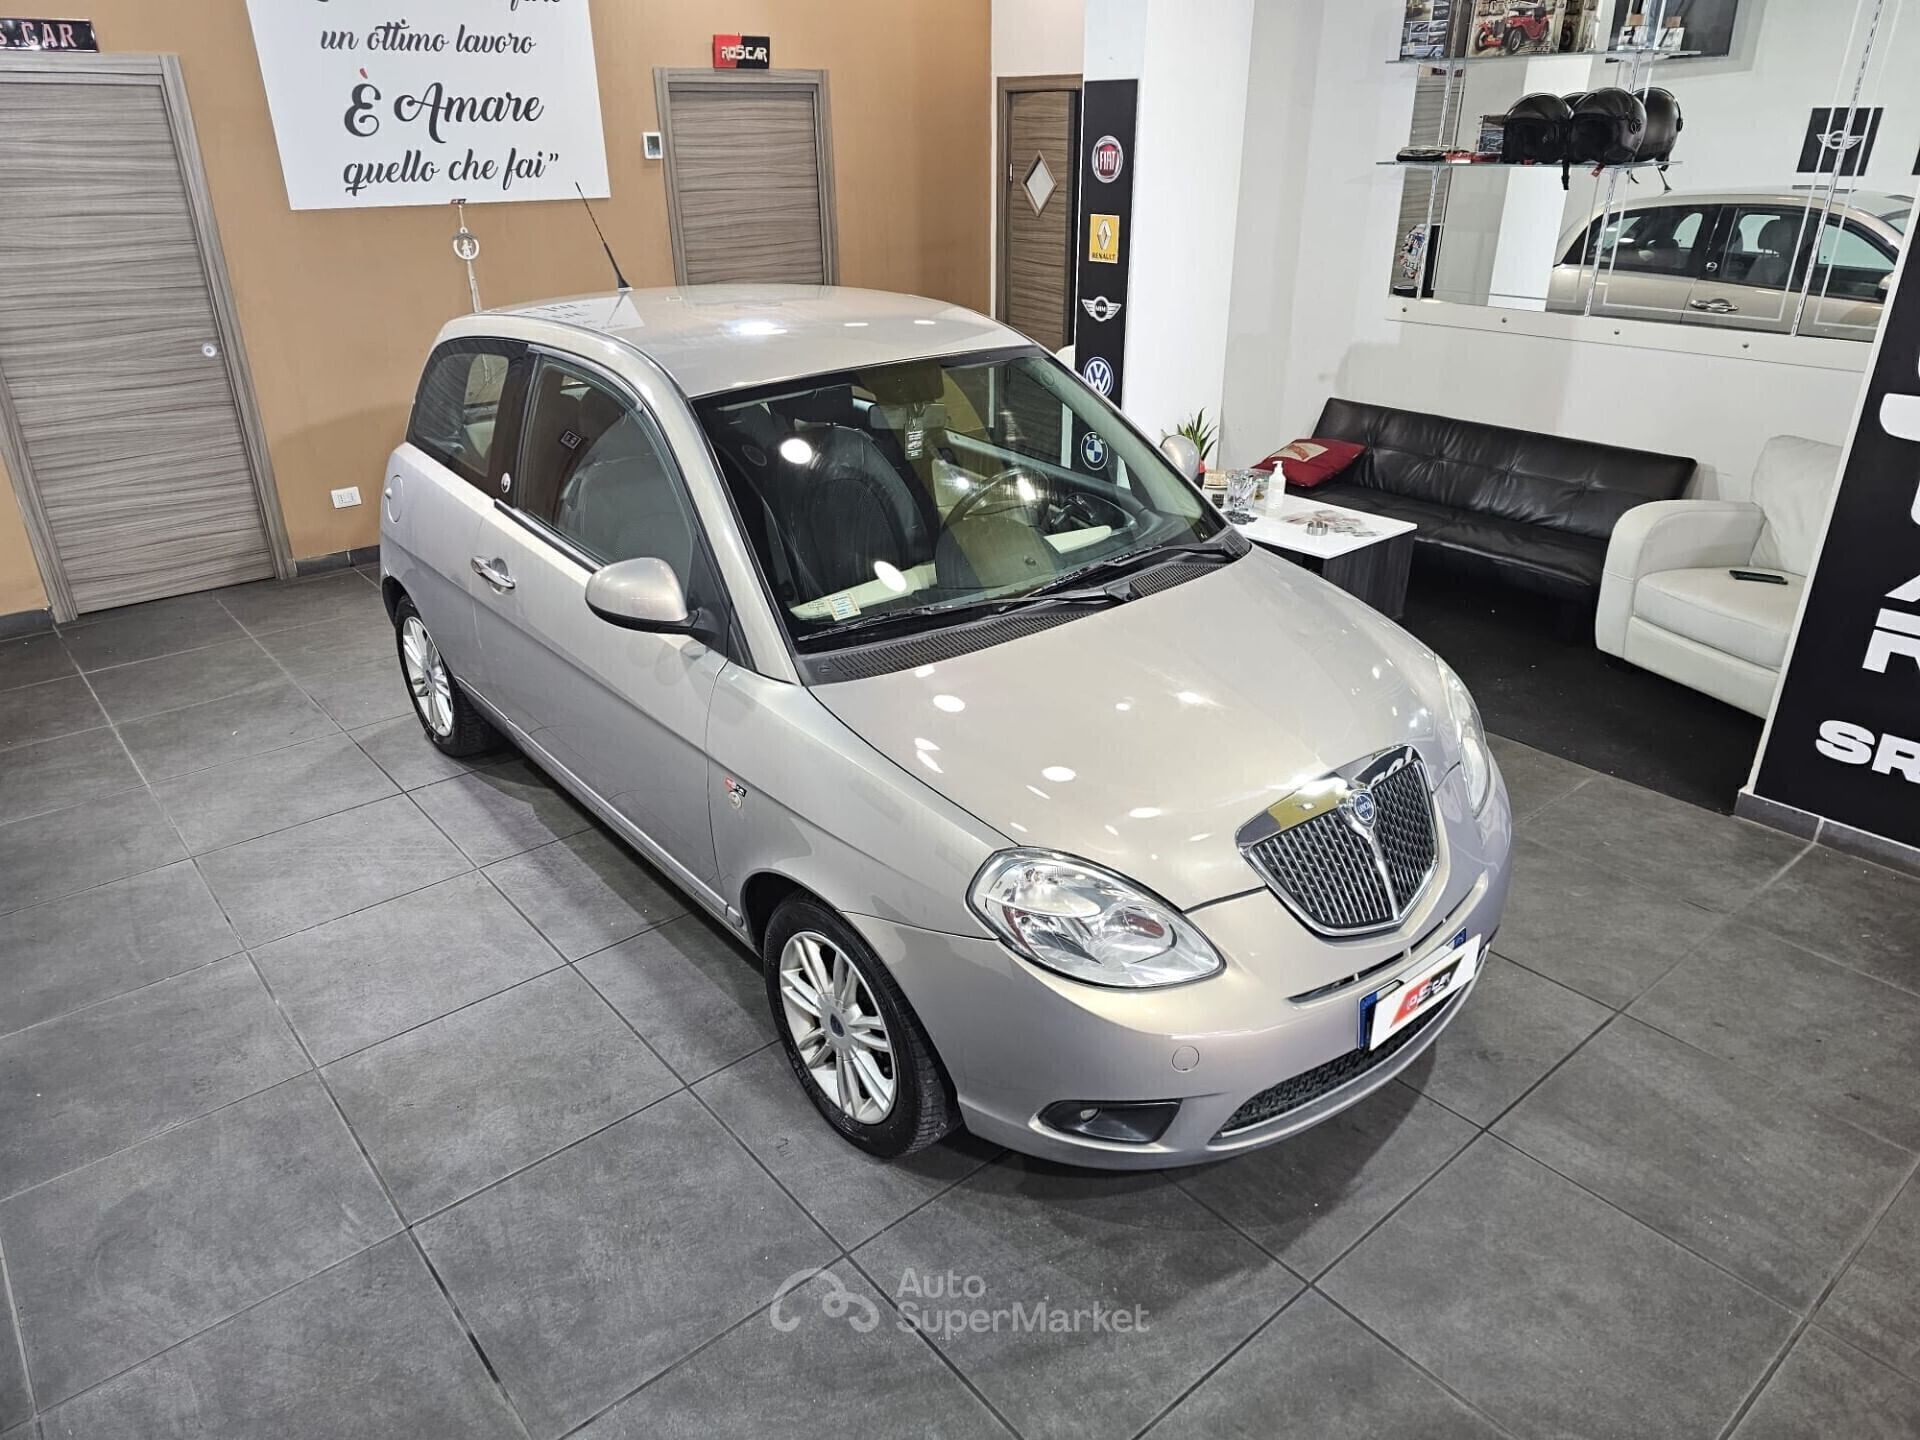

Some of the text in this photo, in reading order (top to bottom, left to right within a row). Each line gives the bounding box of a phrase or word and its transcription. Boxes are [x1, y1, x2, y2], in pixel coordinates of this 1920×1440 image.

[320, 19, 537, 54] un ottimo lavoro
[343, 67, 545, 144] È Amare
[343, 149, 441, 197] quello
[448, 148, 499, 181] che
[1099, 150, 1117, 170] FIAT
